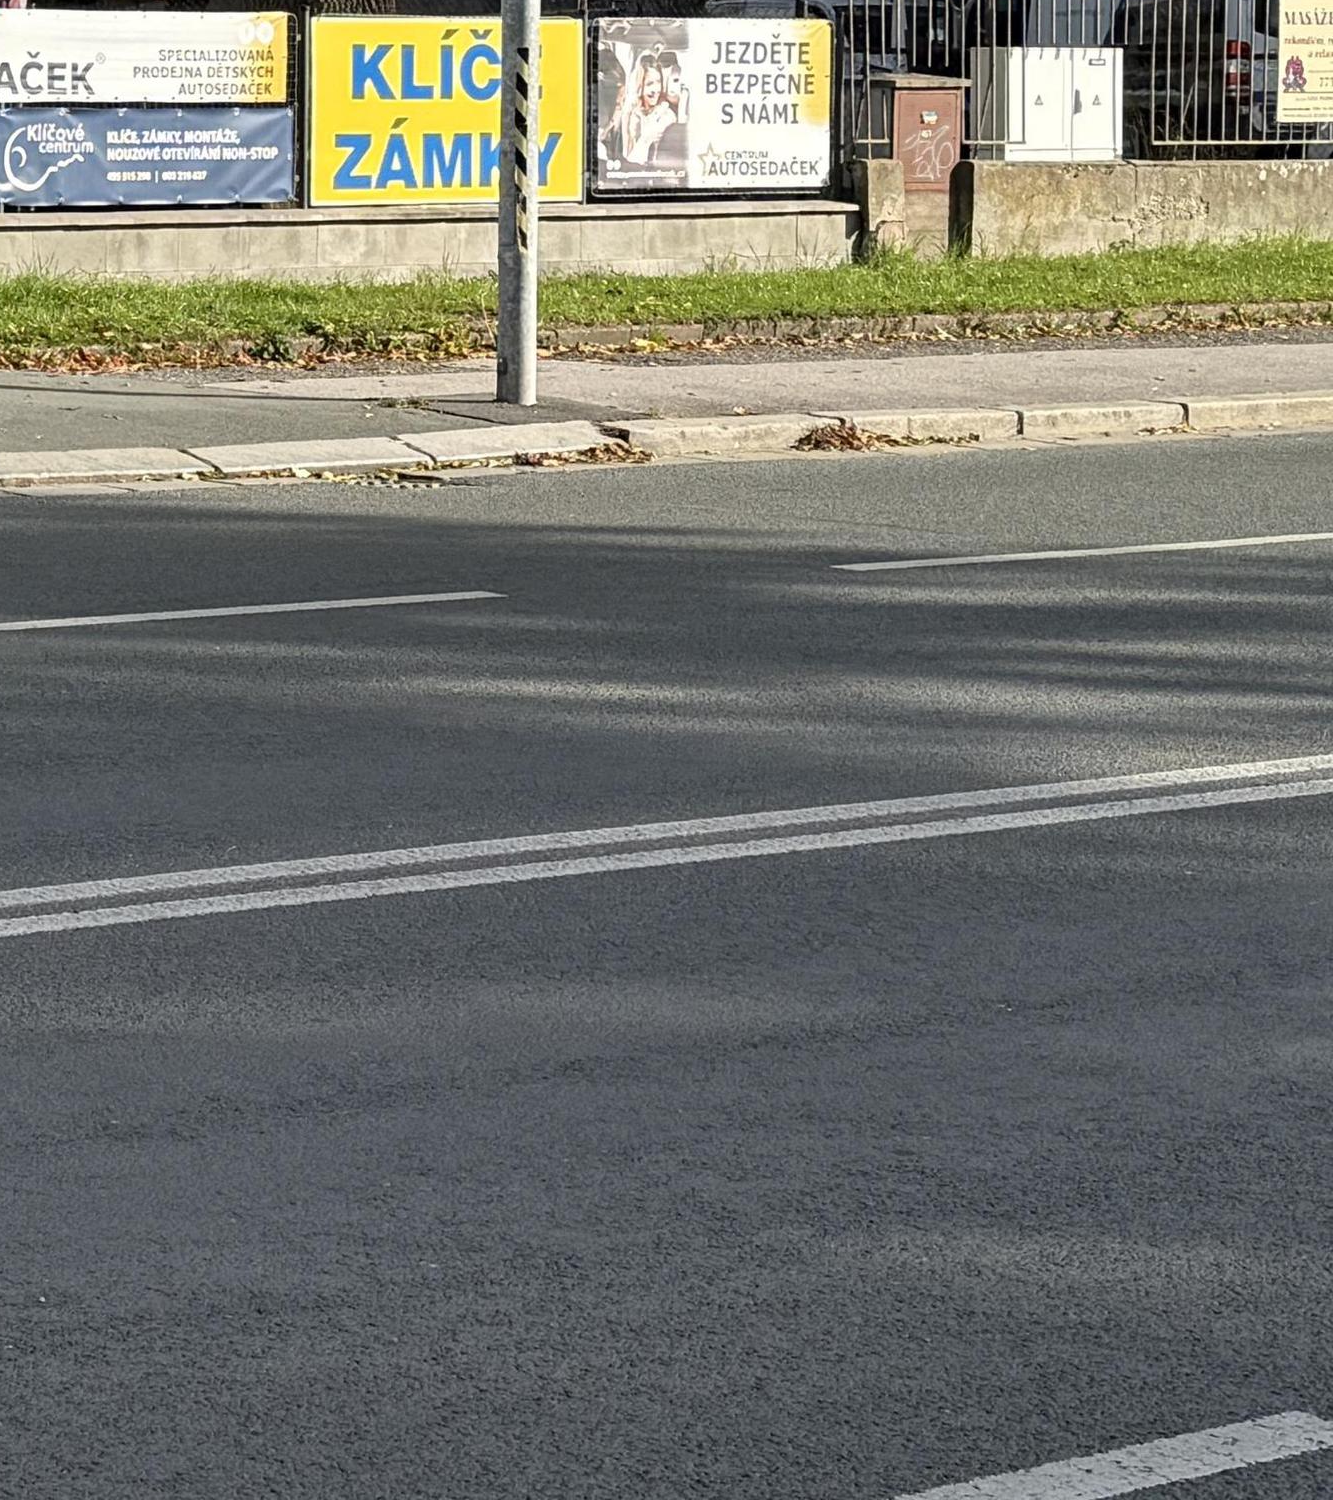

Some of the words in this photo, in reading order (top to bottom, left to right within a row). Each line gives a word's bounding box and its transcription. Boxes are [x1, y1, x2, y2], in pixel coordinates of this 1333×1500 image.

[158, 45, 274, 62] SPECIALIZOVANÁ
[711, 33, 810, 65] JEZDĚTE
[133, 66, 202, 80] PRODEJNA
[206, 62, 274, 80] DĚTSKÝCH
[178, 79, 272, 96] AUTOSEDAČEK
[706, 66, 815, 95] BEZPEČNĚ
[721, 103, 733, 125] S
[742, 95, 799, 125] NÁMI
[26, 123, 85, 142] Klíčové
[107, 130, 141, 145] KLÍČE,
[142, 129, 183, 145] ZÁMKY,
[184, 129, 241, 145] MONTÁŽE,
[38, 140, 94, 154] centrum
[107, 146, 161, 162] NOUZOVÉ
[162, 145, 221, 161] OTEVÍRÁNÍ
[222, 146, 279, 161] NON-STOP
[724, 150, 769, 161] CENTRUM
[708, 156, 819, 176] AUTOSEDAČEK
